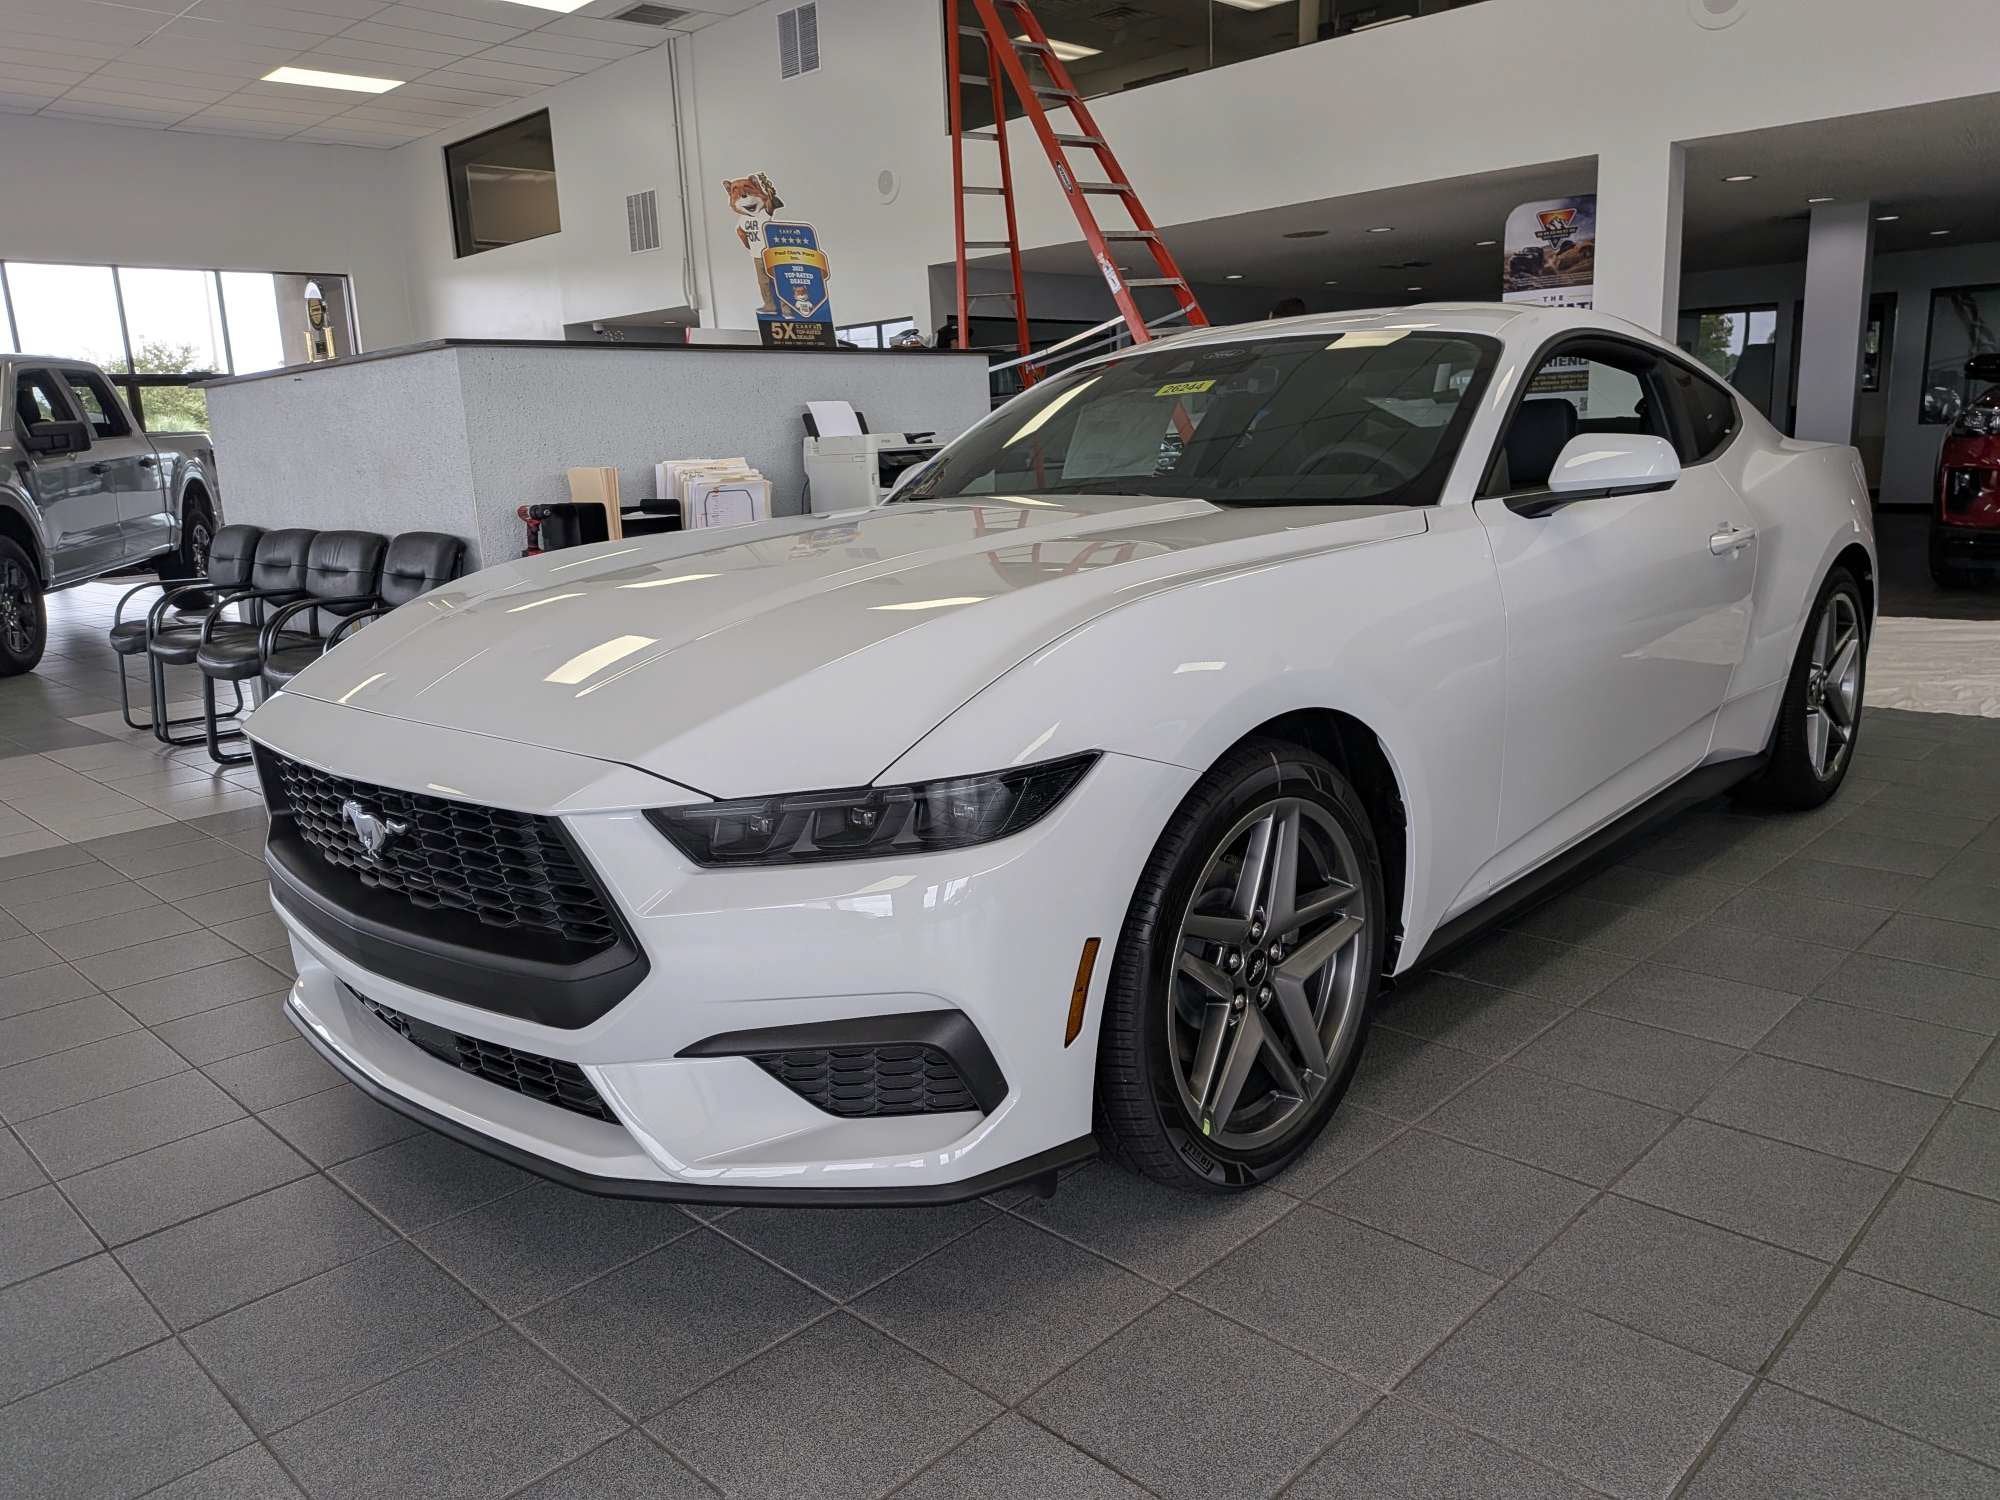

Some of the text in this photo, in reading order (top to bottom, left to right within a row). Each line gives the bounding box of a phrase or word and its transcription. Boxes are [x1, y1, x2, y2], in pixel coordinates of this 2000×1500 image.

[744, 220, 759, 230] CAR
[745, 231, 761, 242] FOX
[771, 322, 797, 340] 5X
